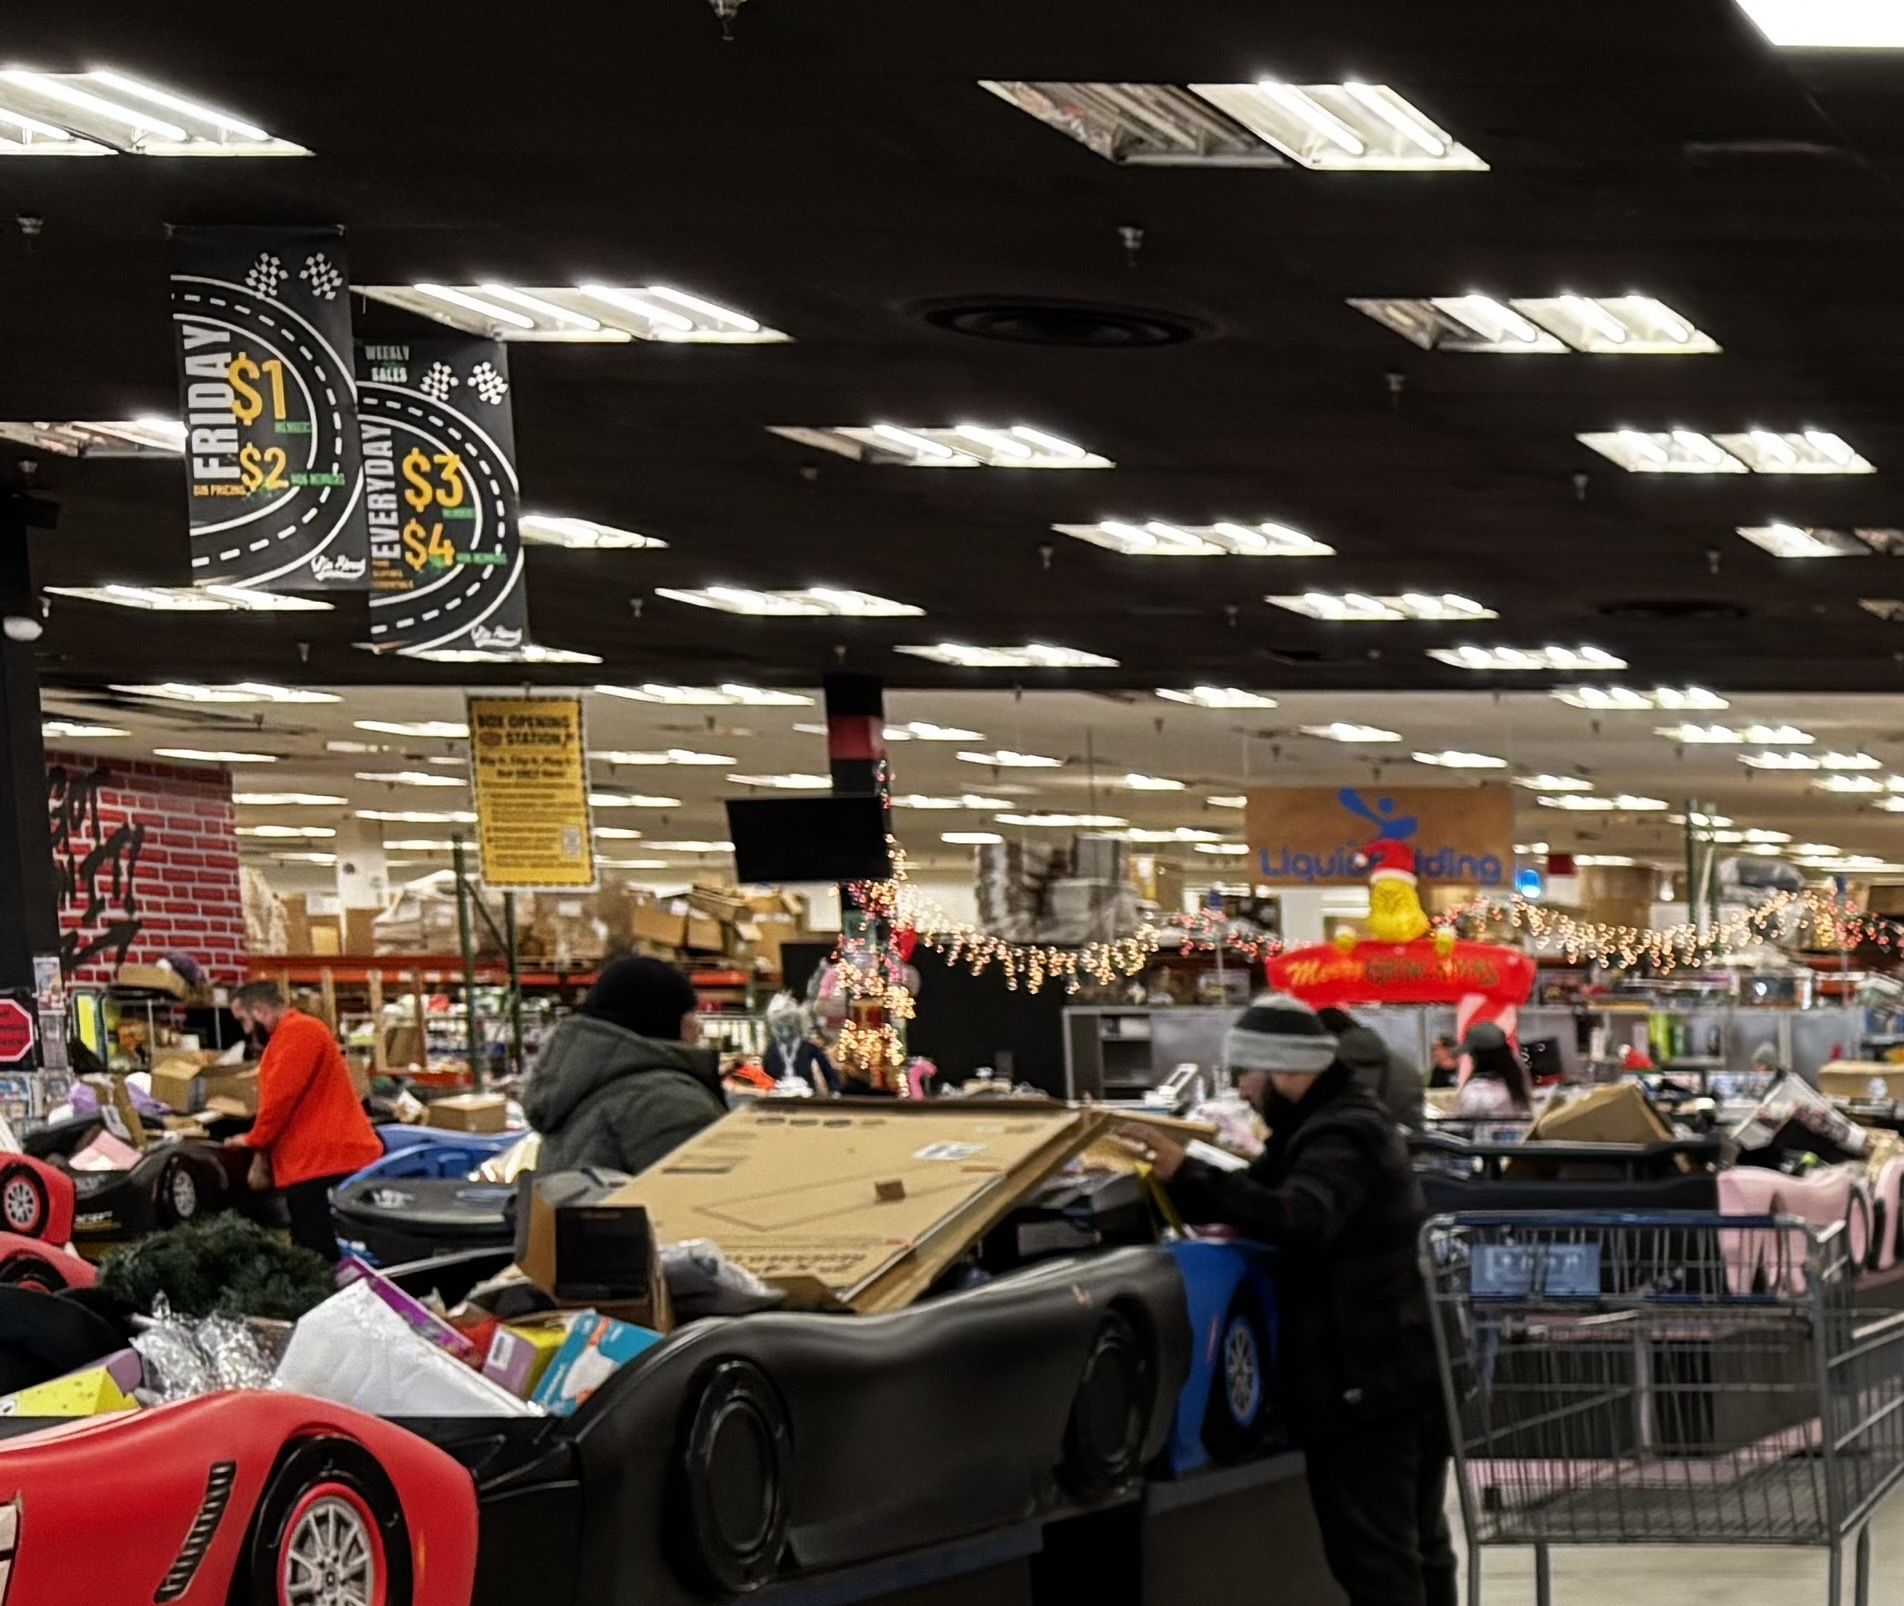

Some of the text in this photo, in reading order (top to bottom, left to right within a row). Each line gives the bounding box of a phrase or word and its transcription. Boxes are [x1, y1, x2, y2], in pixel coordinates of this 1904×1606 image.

[182, 324, 241, 478] FRIDAY
[228, 352, 286, 426] $1
[371, 368, 408, 383] SALES
[240, 442, 289, 492] $2
[361, 424, 401, 559] EVERYDAY
[402, 447, 464, 512] $3
[403, 518, 454, 572] $4
